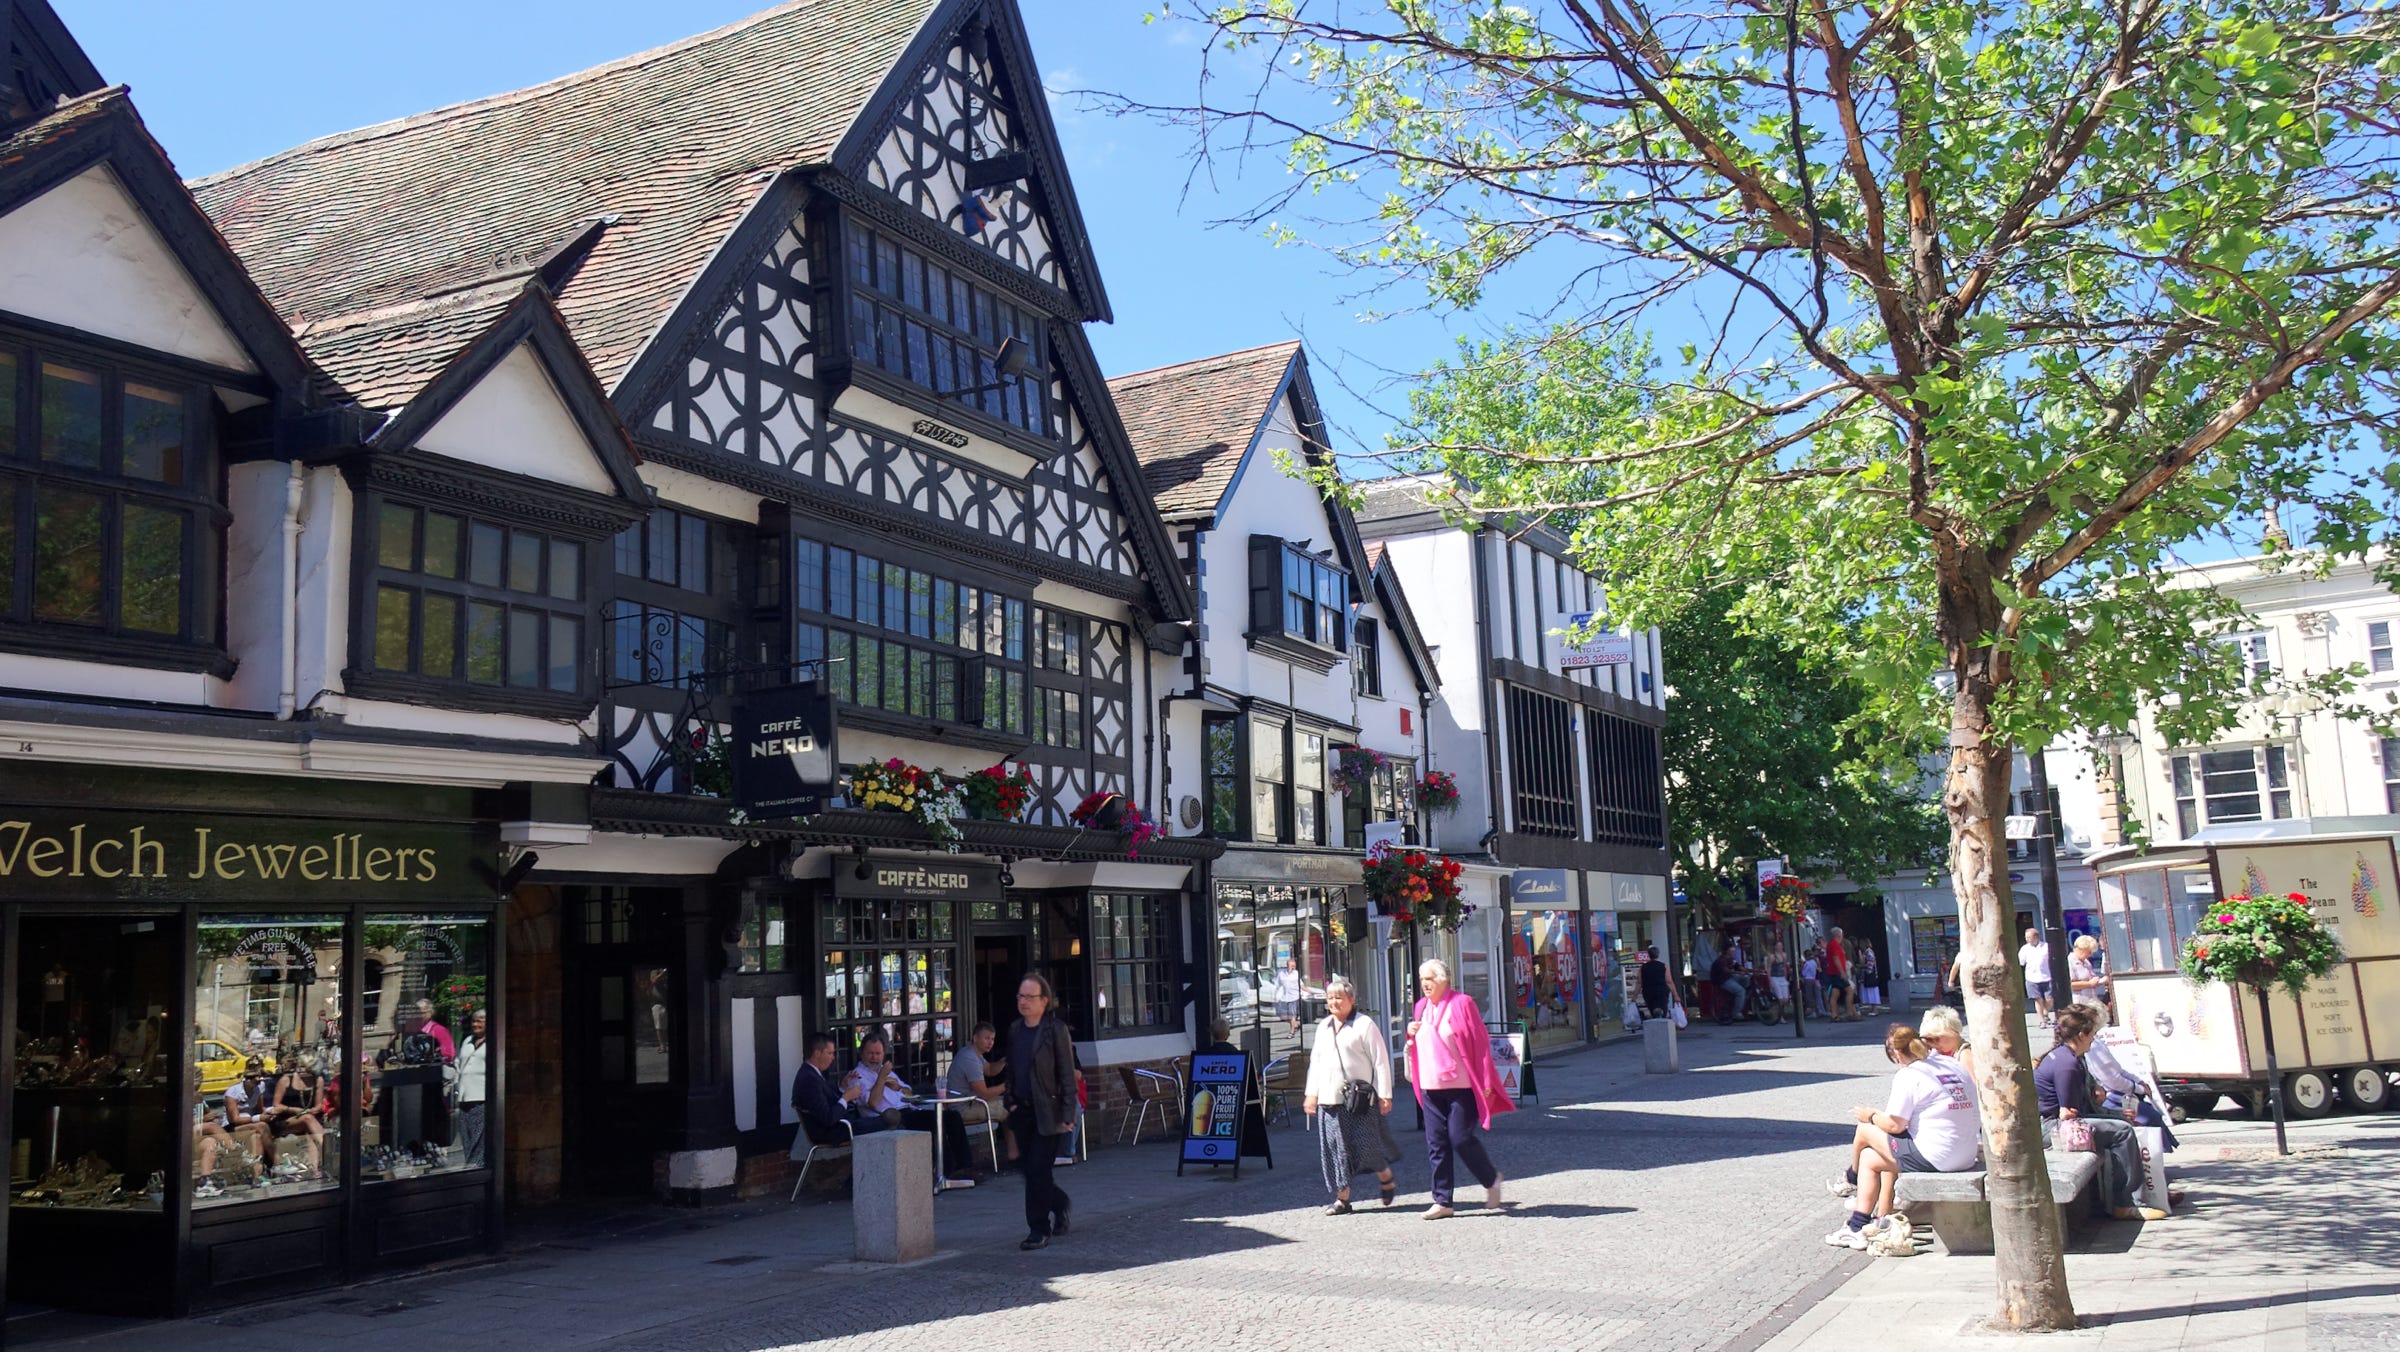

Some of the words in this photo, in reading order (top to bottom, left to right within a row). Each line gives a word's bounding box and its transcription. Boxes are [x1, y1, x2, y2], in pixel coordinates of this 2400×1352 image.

[1560, 656, 1590, 666] 01823
[1592, 653, 1629, 664] 323523
[760, 716, 802, 734] CAFFÈ
[17, 741, 33, 753] 14
[750, 736, 814, 758] NERO
[188, 827, 437, 883] Jewellers
[1292, 857, 1328, 869] PORTMAN
[878, 866, 926, 887] CAFFÈ
[928, 873, 968, 889] NERO
[2300, 878, 2318, 889] The
[262, 942, 287, 953] FREE
[416, 940, 438, 950] FREE
[2310, 999, 2350, 1009] FLAVOURED
[2323, 1013, 2341, 1021] SOFT
[2329, 1026, 2353, 1035] CREAM
[1200, 1065, 1237, 1075] NERO
[1217, 1085, 1238, 1094] 100%
[1216, 1095, 1237, 1104] PURE
[1215, 1104, 1236, 1113] FRUIT
[1215, 1121, 1233, 1136] ICE
